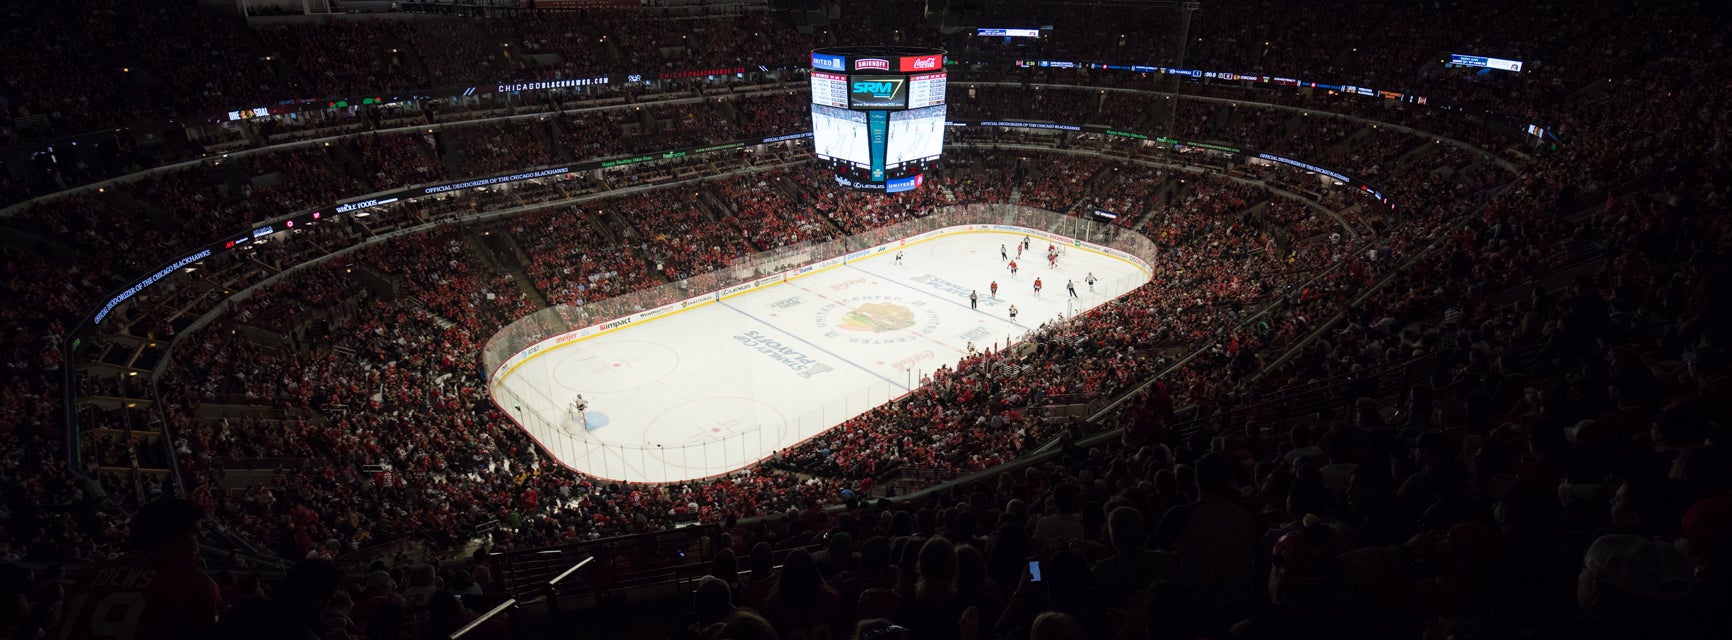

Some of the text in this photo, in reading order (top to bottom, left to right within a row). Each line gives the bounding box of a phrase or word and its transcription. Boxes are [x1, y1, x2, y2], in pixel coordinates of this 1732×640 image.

[813, 58, 832, 66] UNITED
[858, 60, 886, 68] SMIRNOFF
[498, 78, 608, 92] CHICAGOBLACKHAWKS.COM
[853, 81, 893, 93] SRM
[228, 107, 270, 121] ONE GOAL
[1314, 166, 1330, 175] CHICAGO
[453, 180, 489, 189] DEODORIZER
[534, 167, 569, 177] BLACKHAWKS
[336, 204, 357, 213] WHOLE
[358, 200, 377, 208] FOODS
[1050, 235, 1074, 244] HONDA
[142, 277, 153, 288] THE
[152, 266, 174, 282] CHICAGO
[172, 249, 211, 270] BLACKHAWKS
[640, 306, 674, 318] WeatherTech
[606, 317, 631, 330] impact
[556, 332, 577, 344] meijer
[528, 345, 539, 354] AT&T
[734, 335, 808, 371] STANLEY CUP
[744, 330, 816, 364] PLAYOFFS
